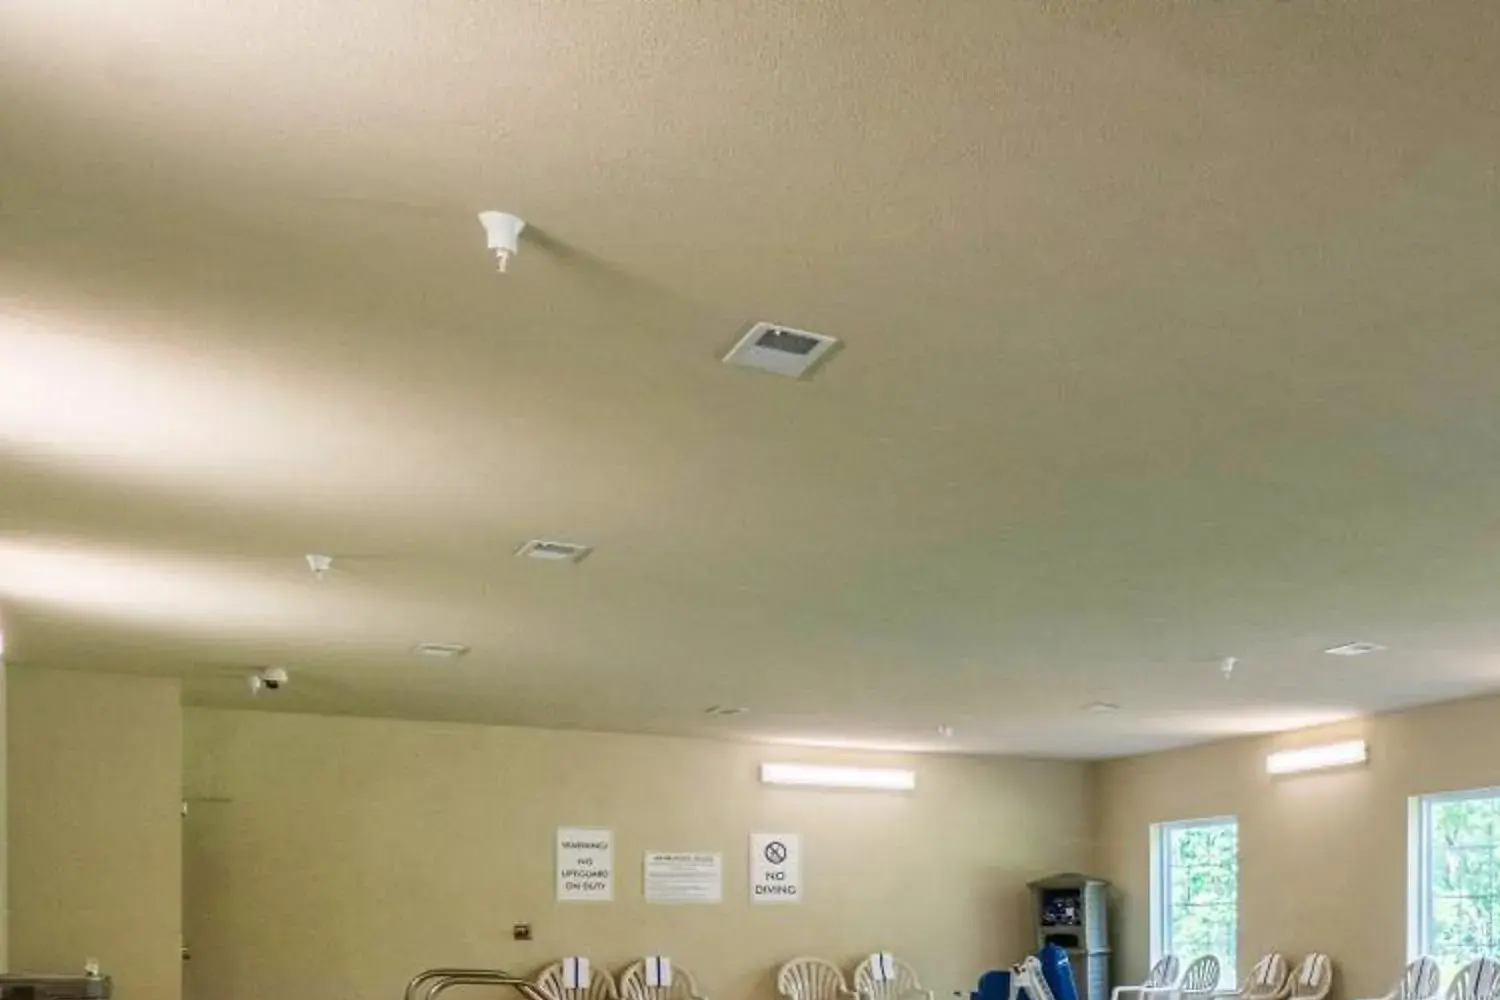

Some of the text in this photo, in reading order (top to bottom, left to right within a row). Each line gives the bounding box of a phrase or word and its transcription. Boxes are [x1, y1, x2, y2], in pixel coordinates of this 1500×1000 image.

[765, 872, 785, 881] NO
[583, 881, 606, 890] DUTY
[755, 885, 797, 895] DIVING
